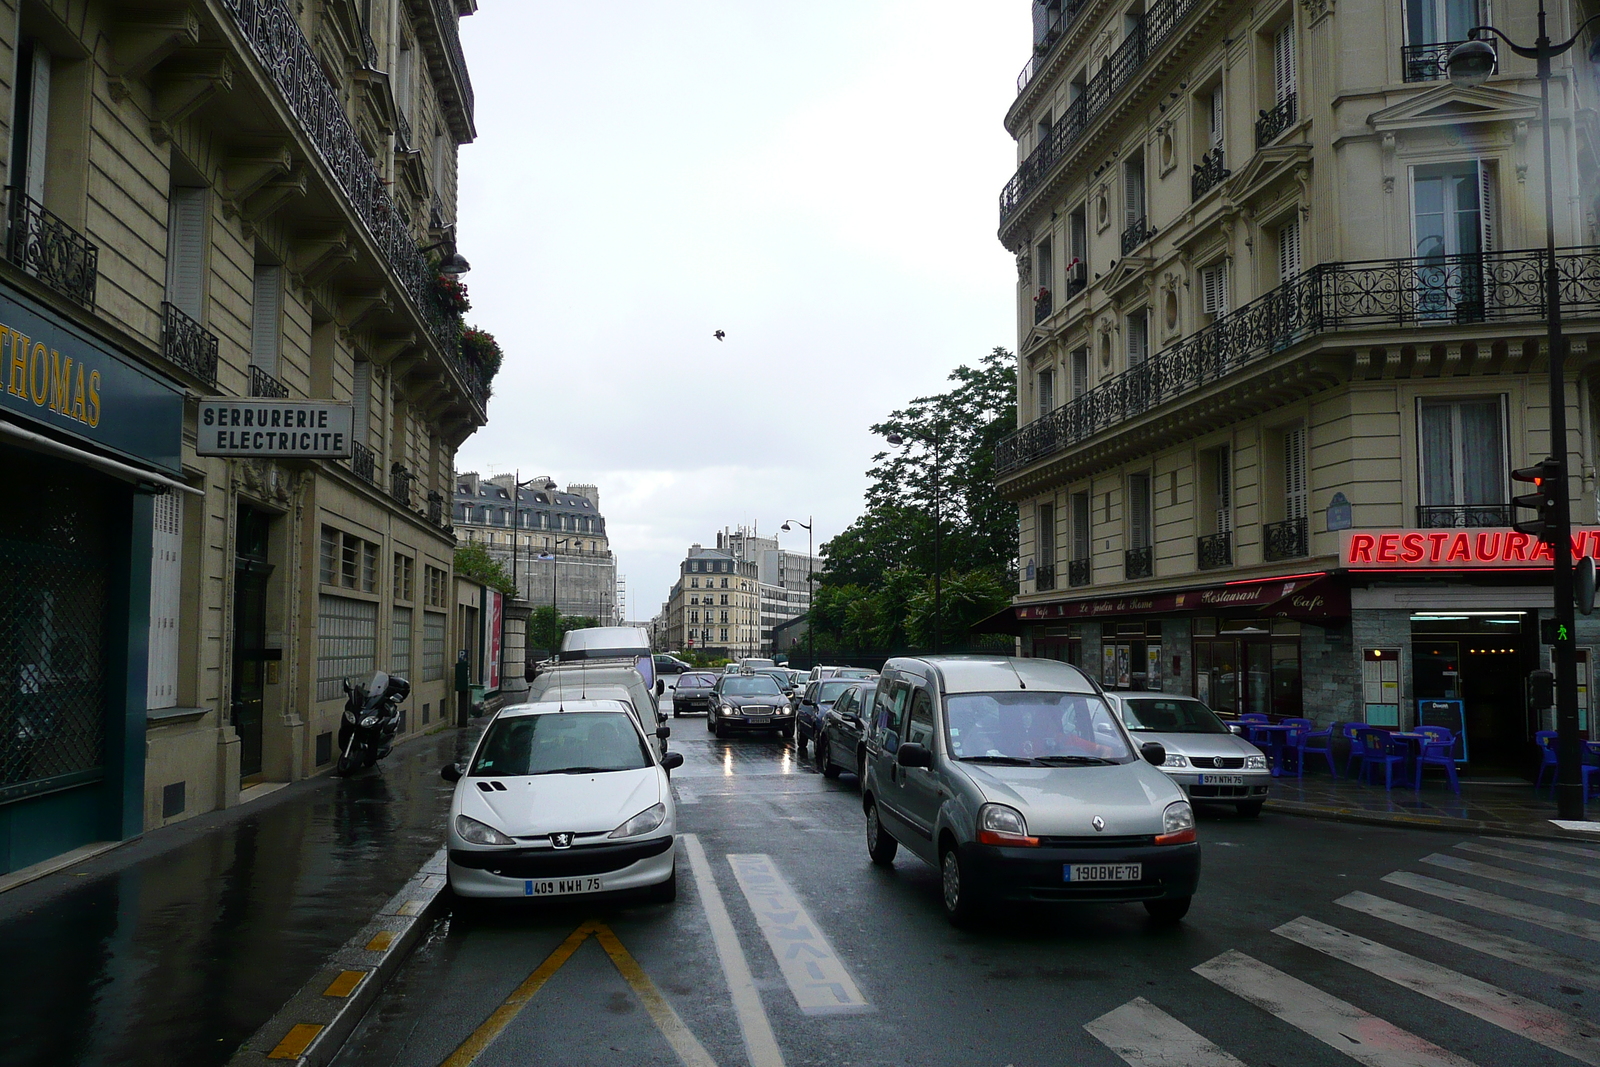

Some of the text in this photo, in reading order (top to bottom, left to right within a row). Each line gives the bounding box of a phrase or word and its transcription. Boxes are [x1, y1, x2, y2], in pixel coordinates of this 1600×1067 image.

[203, 407, 328, 428] SERRURERIE
[217, 431, 344, 451] ELECTRICITE
[1350, 531, 1600, 562] RESTAURANT
[1202, 587, 1262, 603] Restaurant
[1292, 595, 1324, 611] Café
[1117, 599, 1125, 610] de
[534, 878, 600, 894] 409 NWH 75
